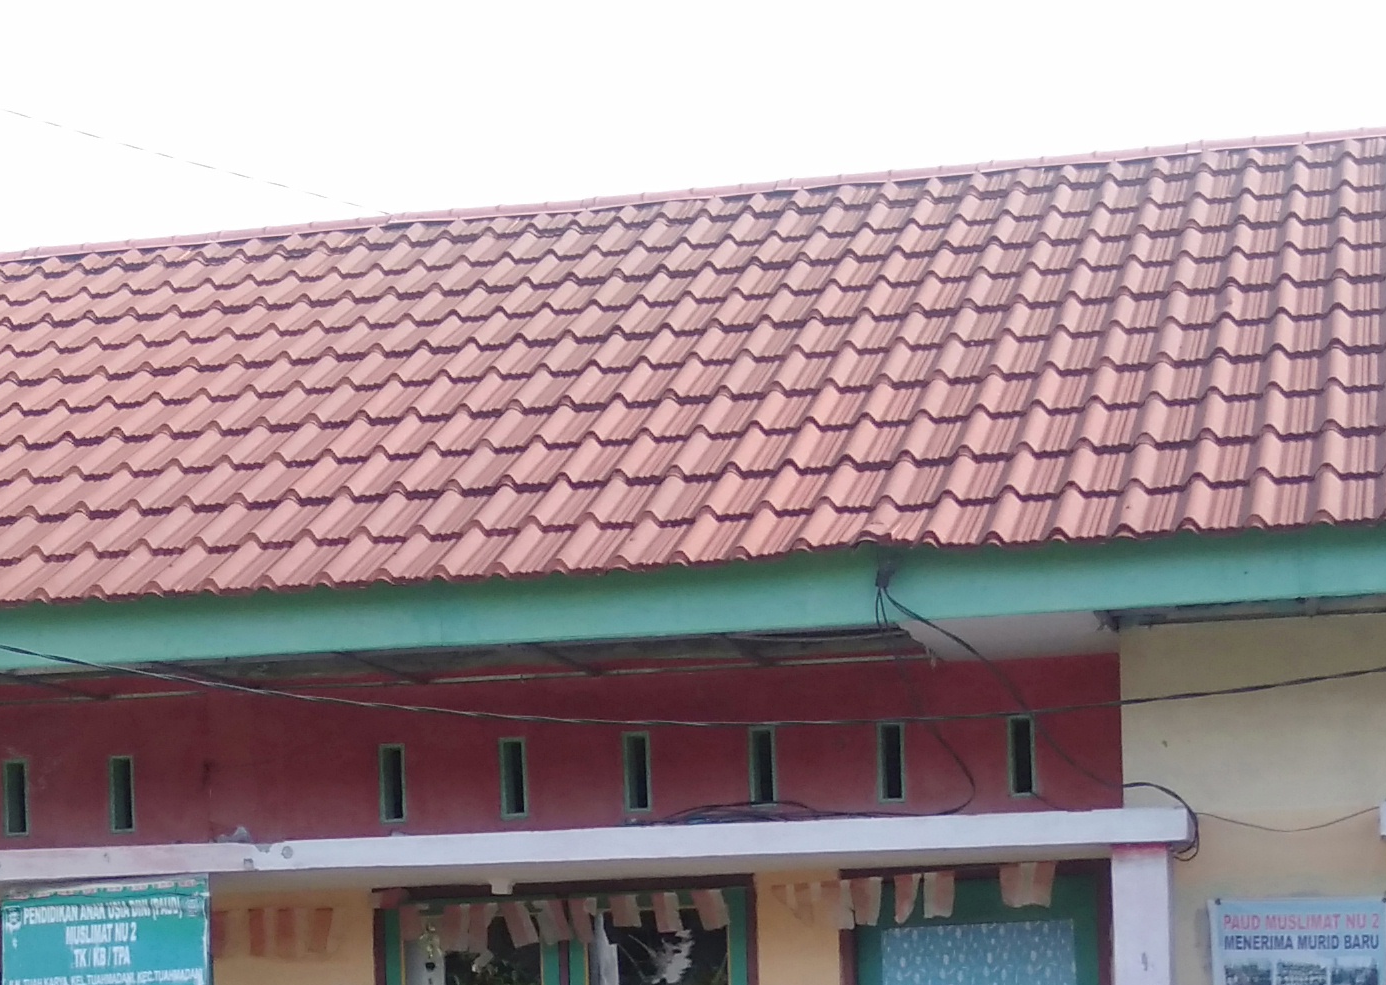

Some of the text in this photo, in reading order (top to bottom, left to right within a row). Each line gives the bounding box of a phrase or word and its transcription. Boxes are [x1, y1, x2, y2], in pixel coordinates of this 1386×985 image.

[23, 904, 78, 925] PENDIDIKAN
[80, 903, 106, 921] ANAK
[131, 900, 150, 918] DINI
[1223, 913, 1380, 931] PAUD MUSLIMAT NU 2
[66, 922, 137, 944] MUSLIMAT NU 2
[1224, 934, 1379, 950] MENERIMA MURID BARU
[73, 948, 87, 967] TK
[93, 947, 106, 966] KB
[113, 946, 130, 965] TPA
